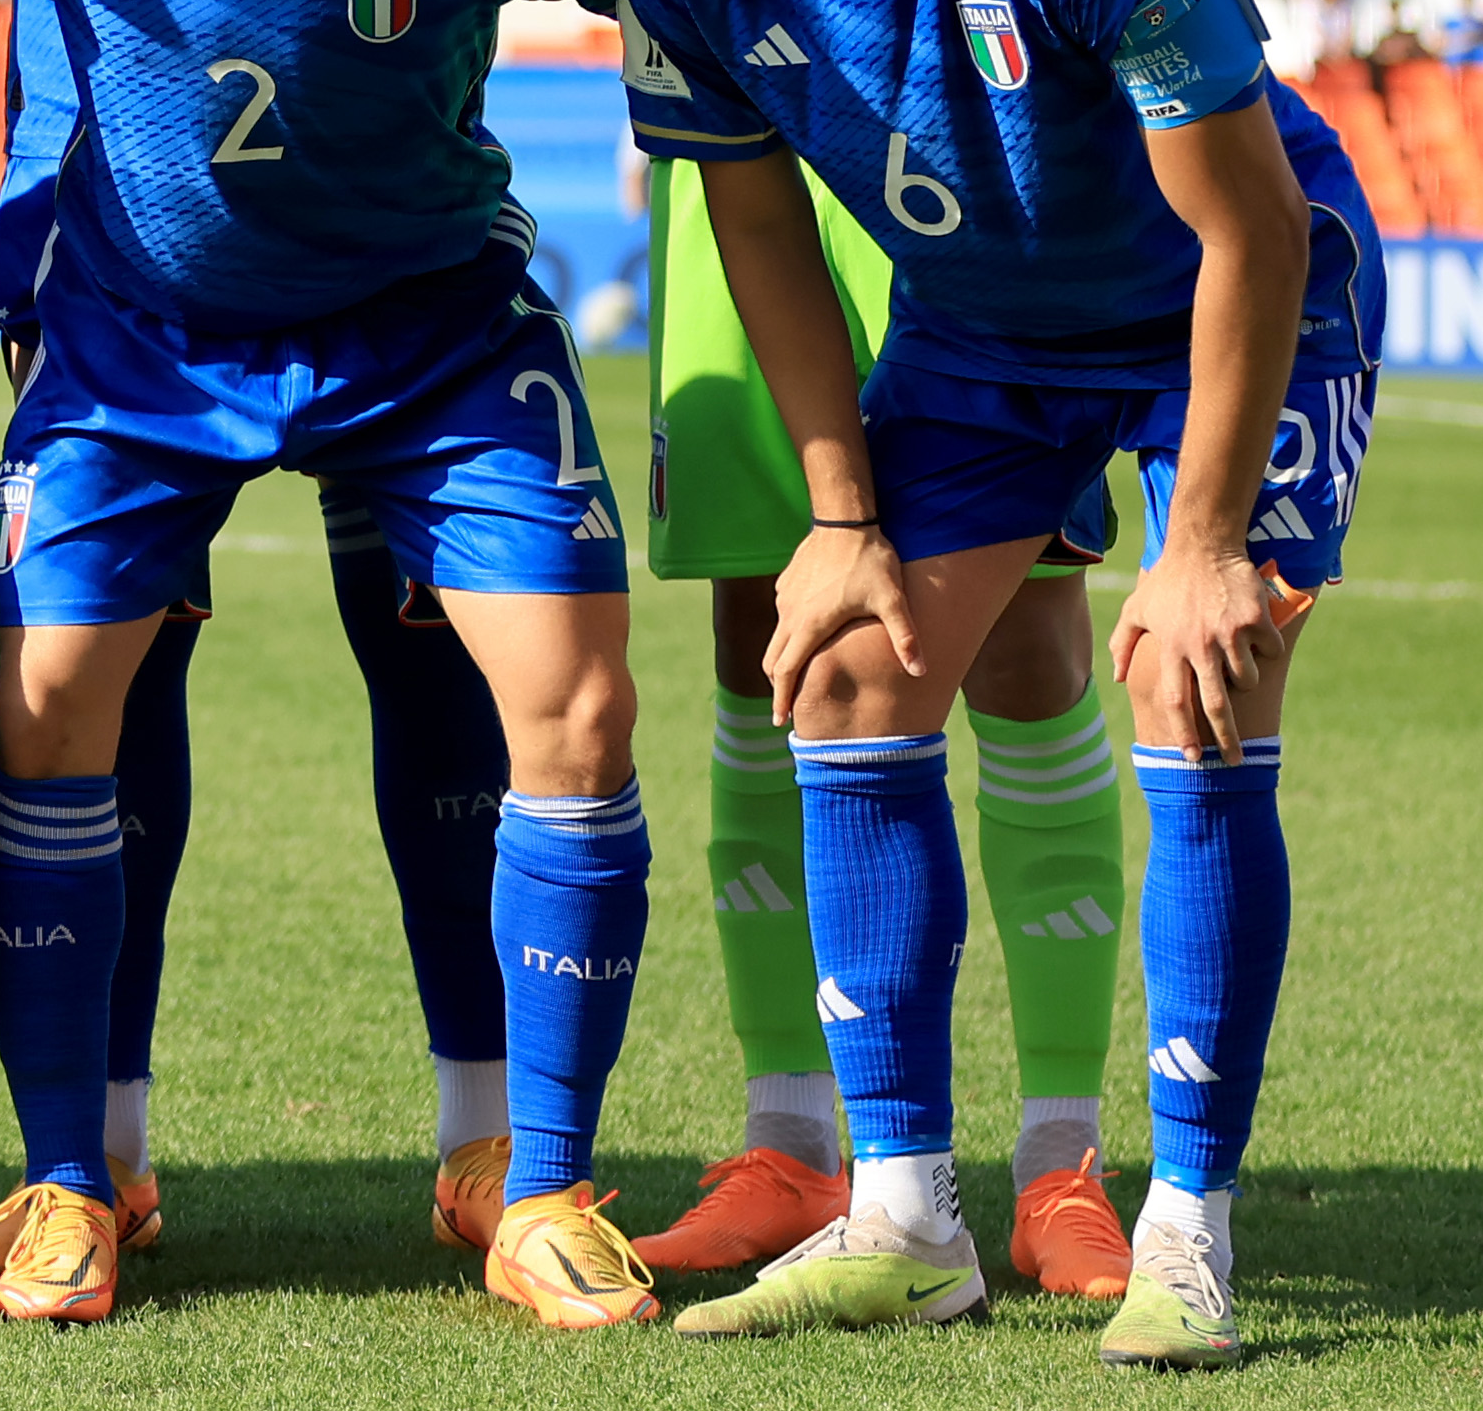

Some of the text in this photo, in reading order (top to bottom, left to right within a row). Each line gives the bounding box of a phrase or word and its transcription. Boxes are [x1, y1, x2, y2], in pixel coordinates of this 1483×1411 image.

[962, 7, 1012, 27] ITALIA
[1114, 41, 1181, 71] FOOTBALL
[1120, 51, 1190, 87] UNITES
[1153, 65, 1203, 98] World
[206, 57, 284, 163] 2
[1146, 104, 1180, 118] FIFA
[885, 132, 962, 236] 6
[510, 370, 603, 487] 2
[523, 945, 633, 980] ITALIA
